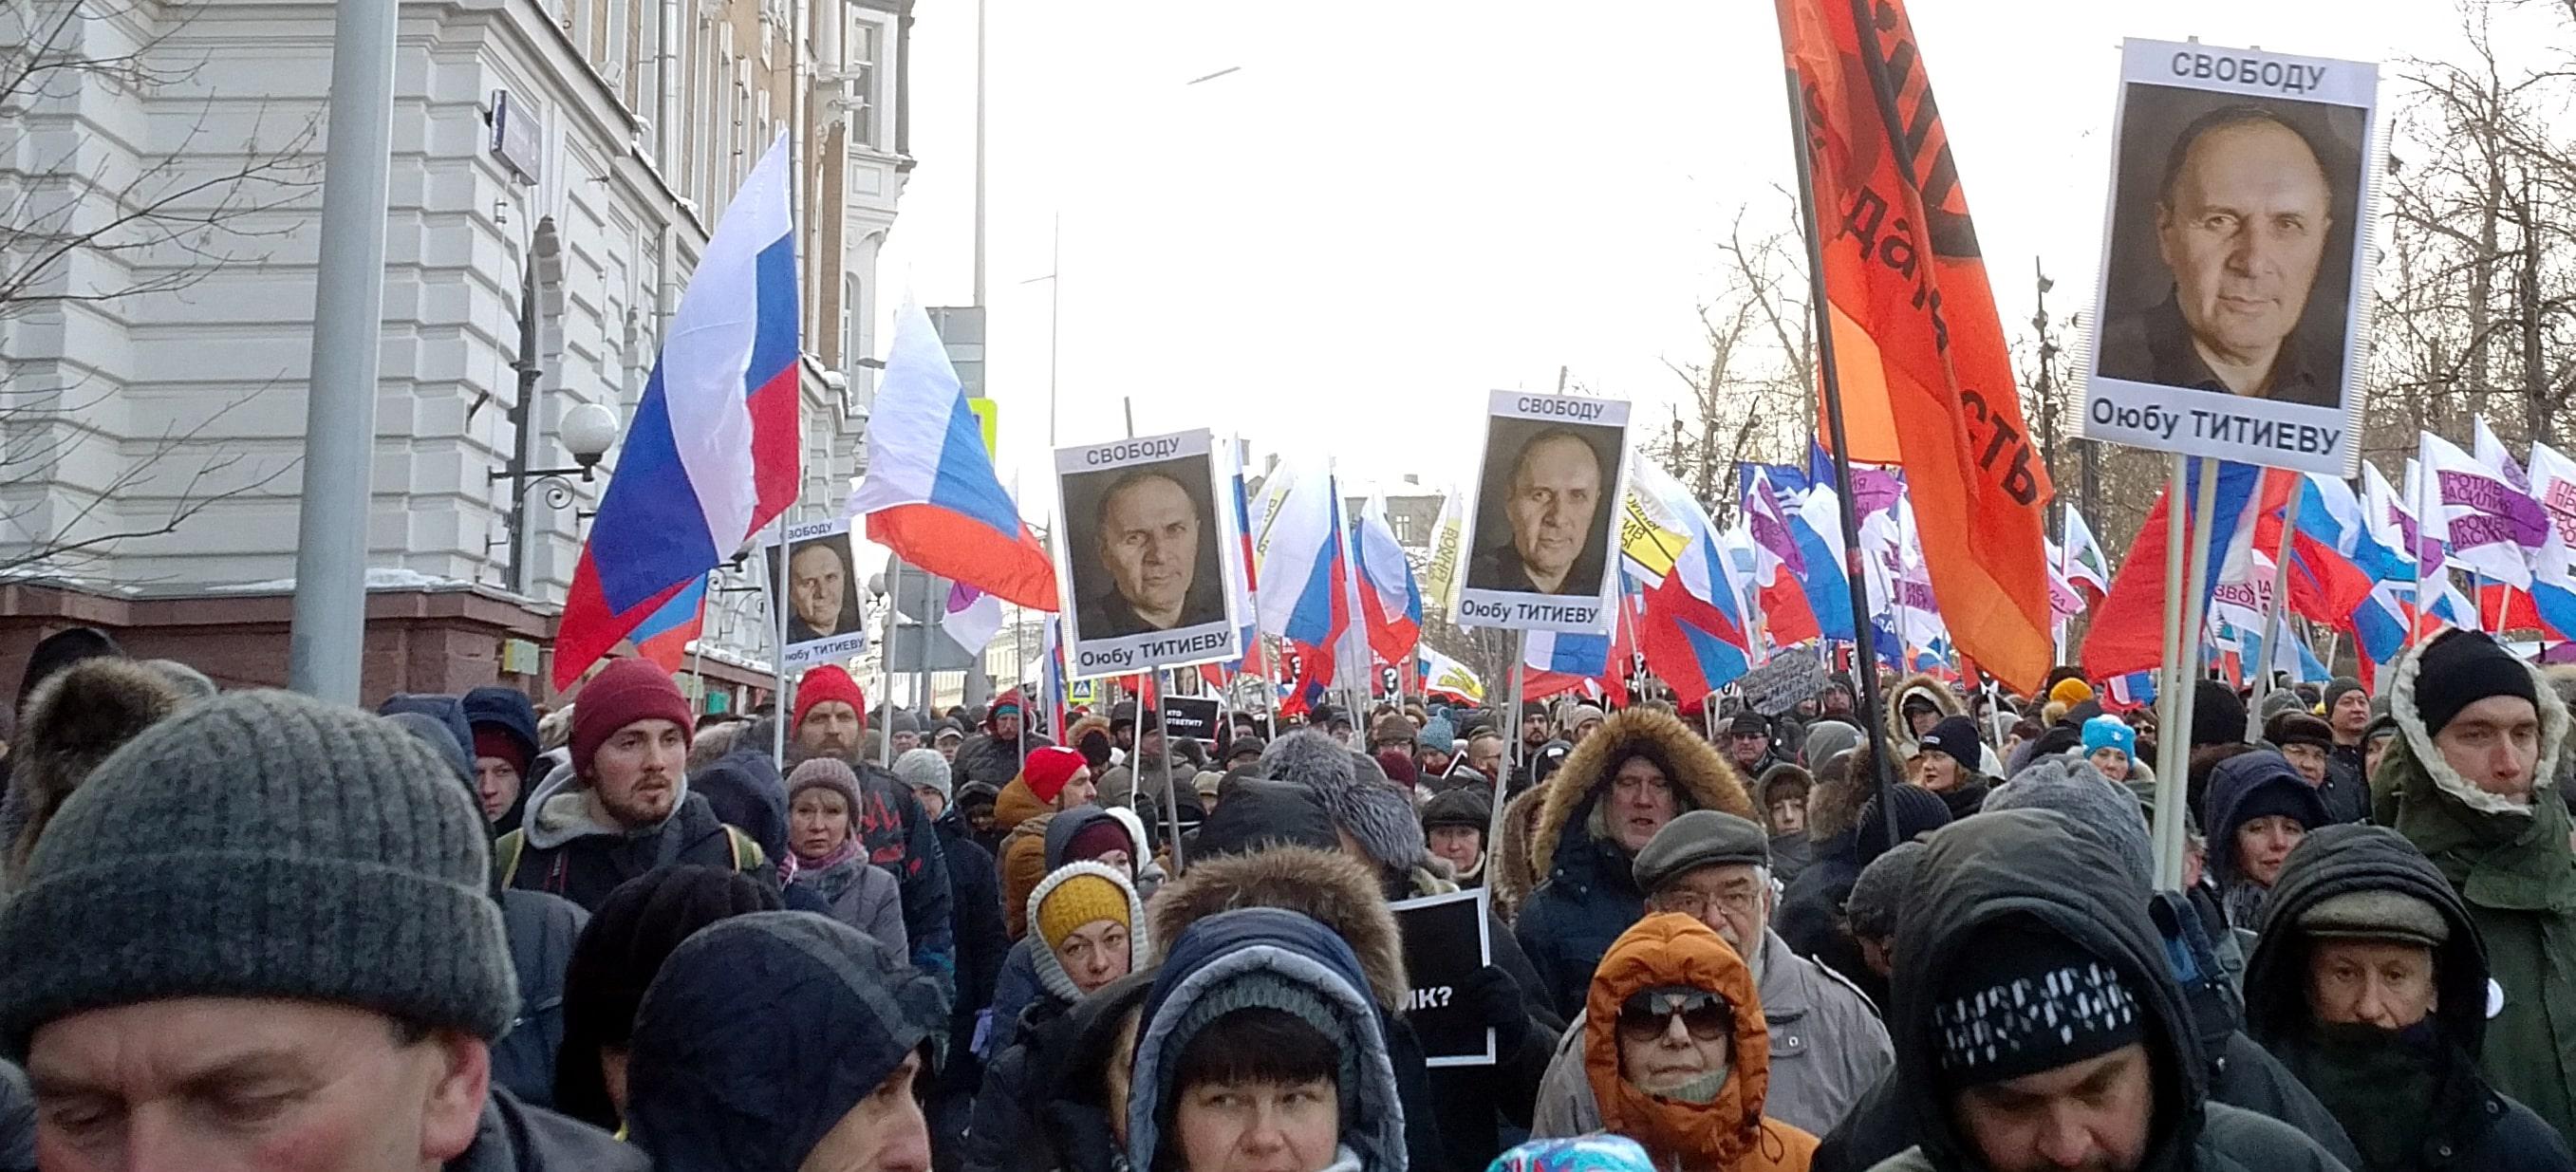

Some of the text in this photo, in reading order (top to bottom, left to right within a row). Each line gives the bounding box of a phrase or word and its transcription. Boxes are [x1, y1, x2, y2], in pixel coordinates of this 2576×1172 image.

[2172, 51, 2326, 93] СВОБОДУ
[1518, 397, 1605, 419] СВОБОДУ
[2091, 397, 2343, 456] Оюбу ТИТИЕВУ
[1086, 437, 1180, 465] СВОБОДУ
[780, 523, 832, 539] ВОБОДУ
[1461, 600, 1598, 623] Оюбу ТИТИЕВУ
[785, 638, 865, 660] юбу ТИТИЕВУ
[1080, 631, 1229, 667] Оюбу ТИТИЕВУ
[1397, 986, 1452, 1012] ИК?
